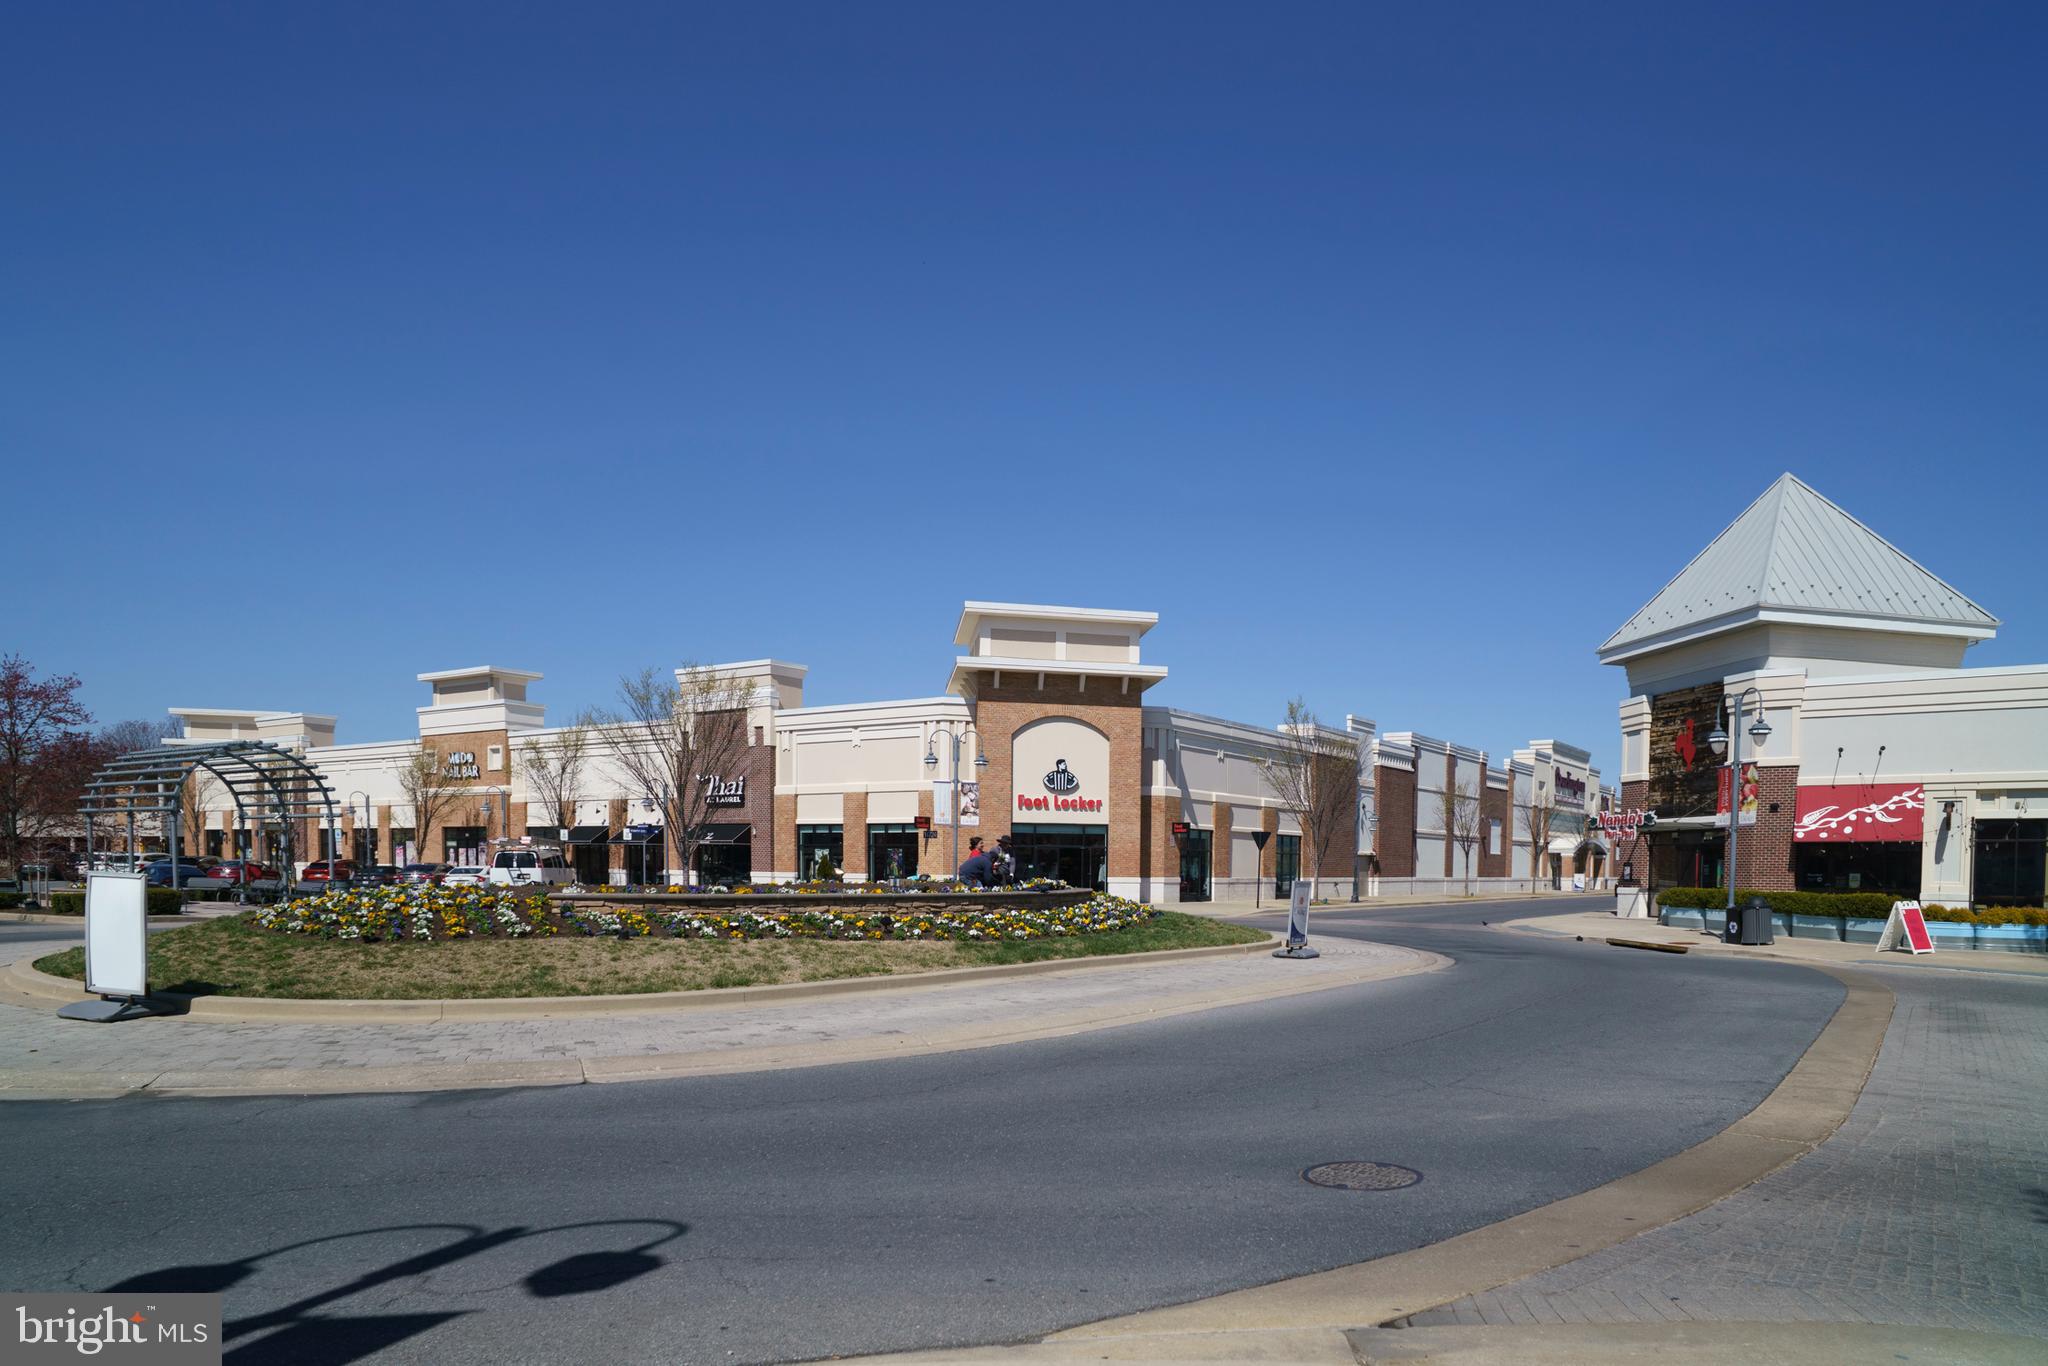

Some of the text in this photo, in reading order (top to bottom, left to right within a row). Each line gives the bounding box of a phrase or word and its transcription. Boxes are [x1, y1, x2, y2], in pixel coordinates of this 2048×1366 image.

[463, 765, 479, 777] BAR
[1017, 794, 1103, 813] Foot Locker
[1598, 808, 1644, 827] Nando's
